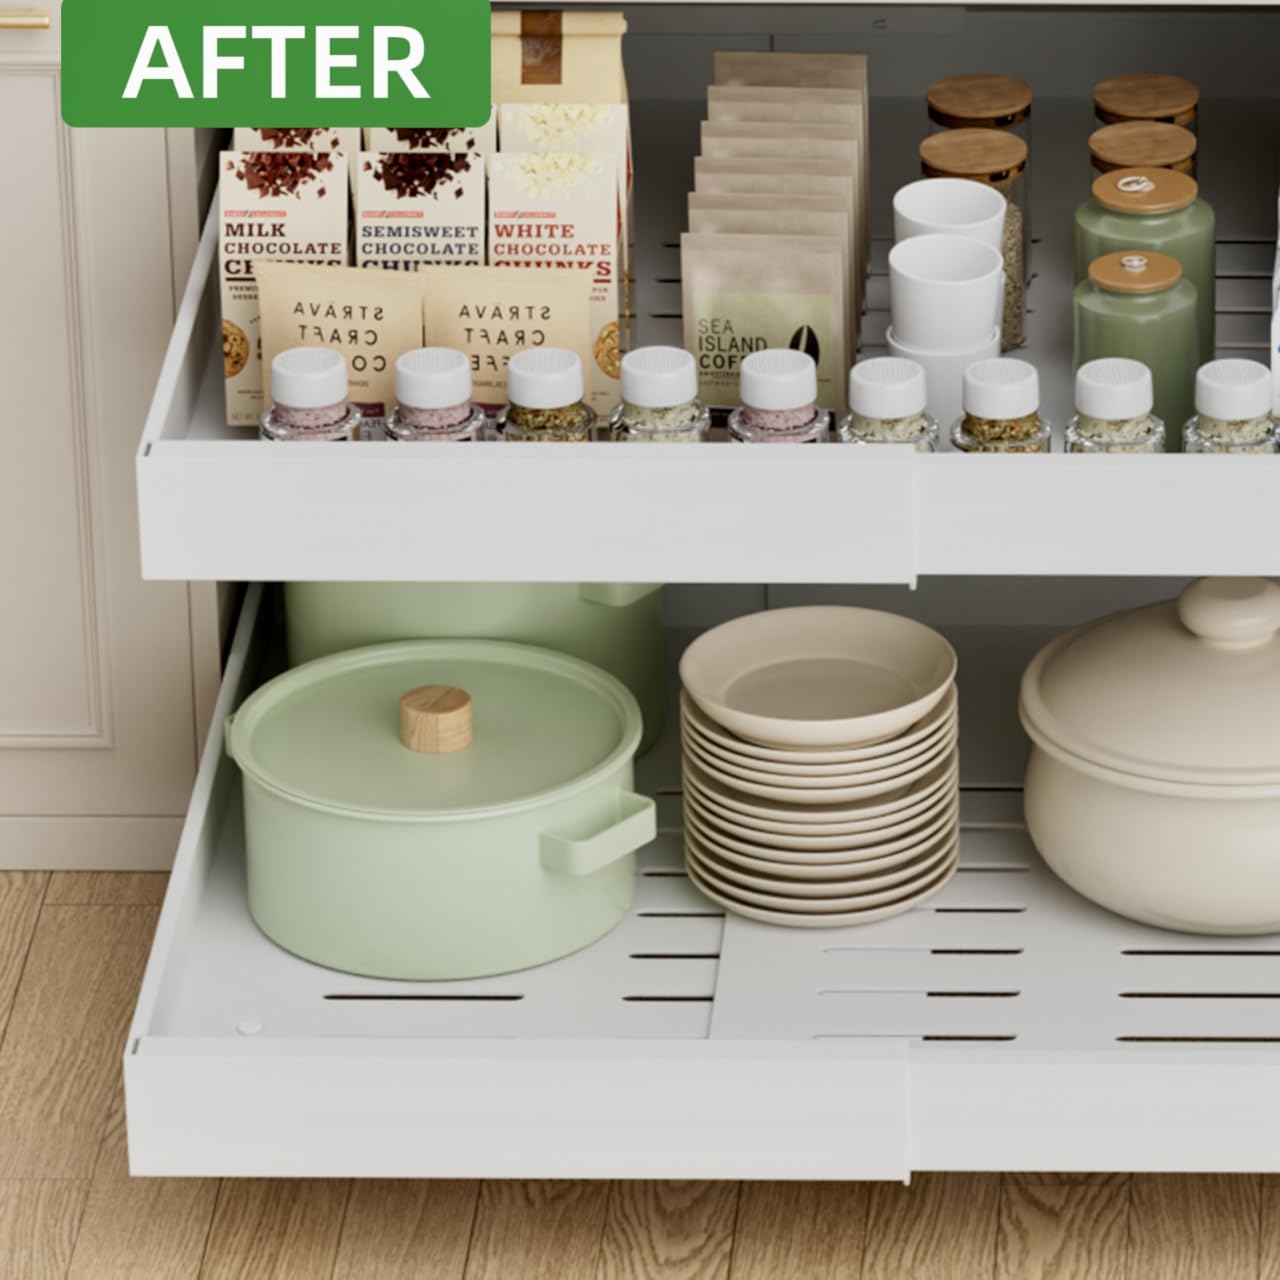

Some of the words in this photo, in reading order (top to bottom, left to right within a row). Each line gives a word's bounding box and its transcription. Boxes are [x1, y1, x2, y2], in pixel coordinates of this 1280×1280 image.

[225, 223, 286, 237] MILK
[362, 226, 480, 238] SEMISWEET
[494, 223, 575, 238] WHITE
[224, 242, 342, 255] CHOCOLATE
[362, 243, 479, 255] CHOCOLATE
[494, 243, 612, 256] CHOCOLATE
[698, 318, 735, 335] SEA
[698, 336, 769, 353] ISLAND
[699, 354, 746, 369] COF
